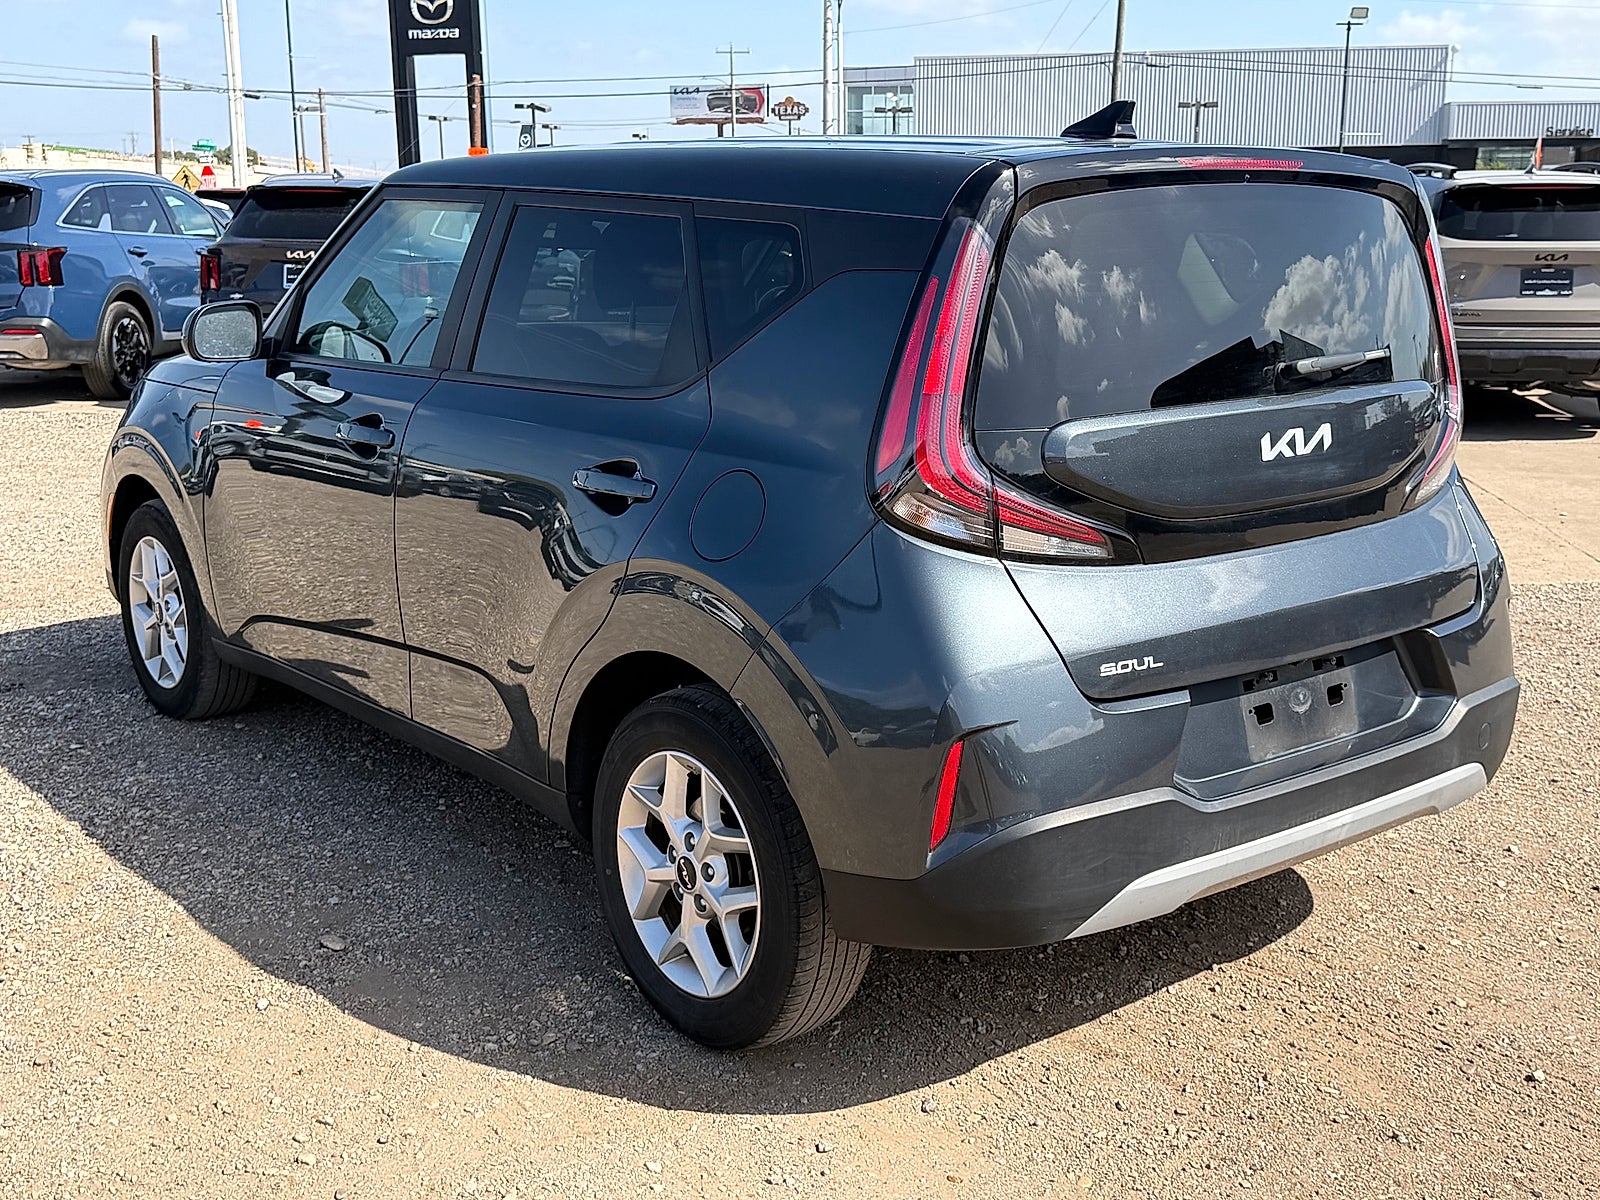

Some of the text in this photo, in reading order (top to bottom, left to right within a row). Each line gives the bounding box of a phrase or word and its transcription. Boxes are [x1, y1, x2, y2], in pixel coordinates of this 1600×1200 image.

[408, 28, 460, 39] mazda
[774, 106, 806, 115] TEXAS
[1546, 126, 1594, 137] Service
[286, 250, 316, 259] KIA
[1535, 253, 1569, 261] KIA
[1260, 422, 1333, 462] KIA
[1099, 655, 1164, 677] SOUL
